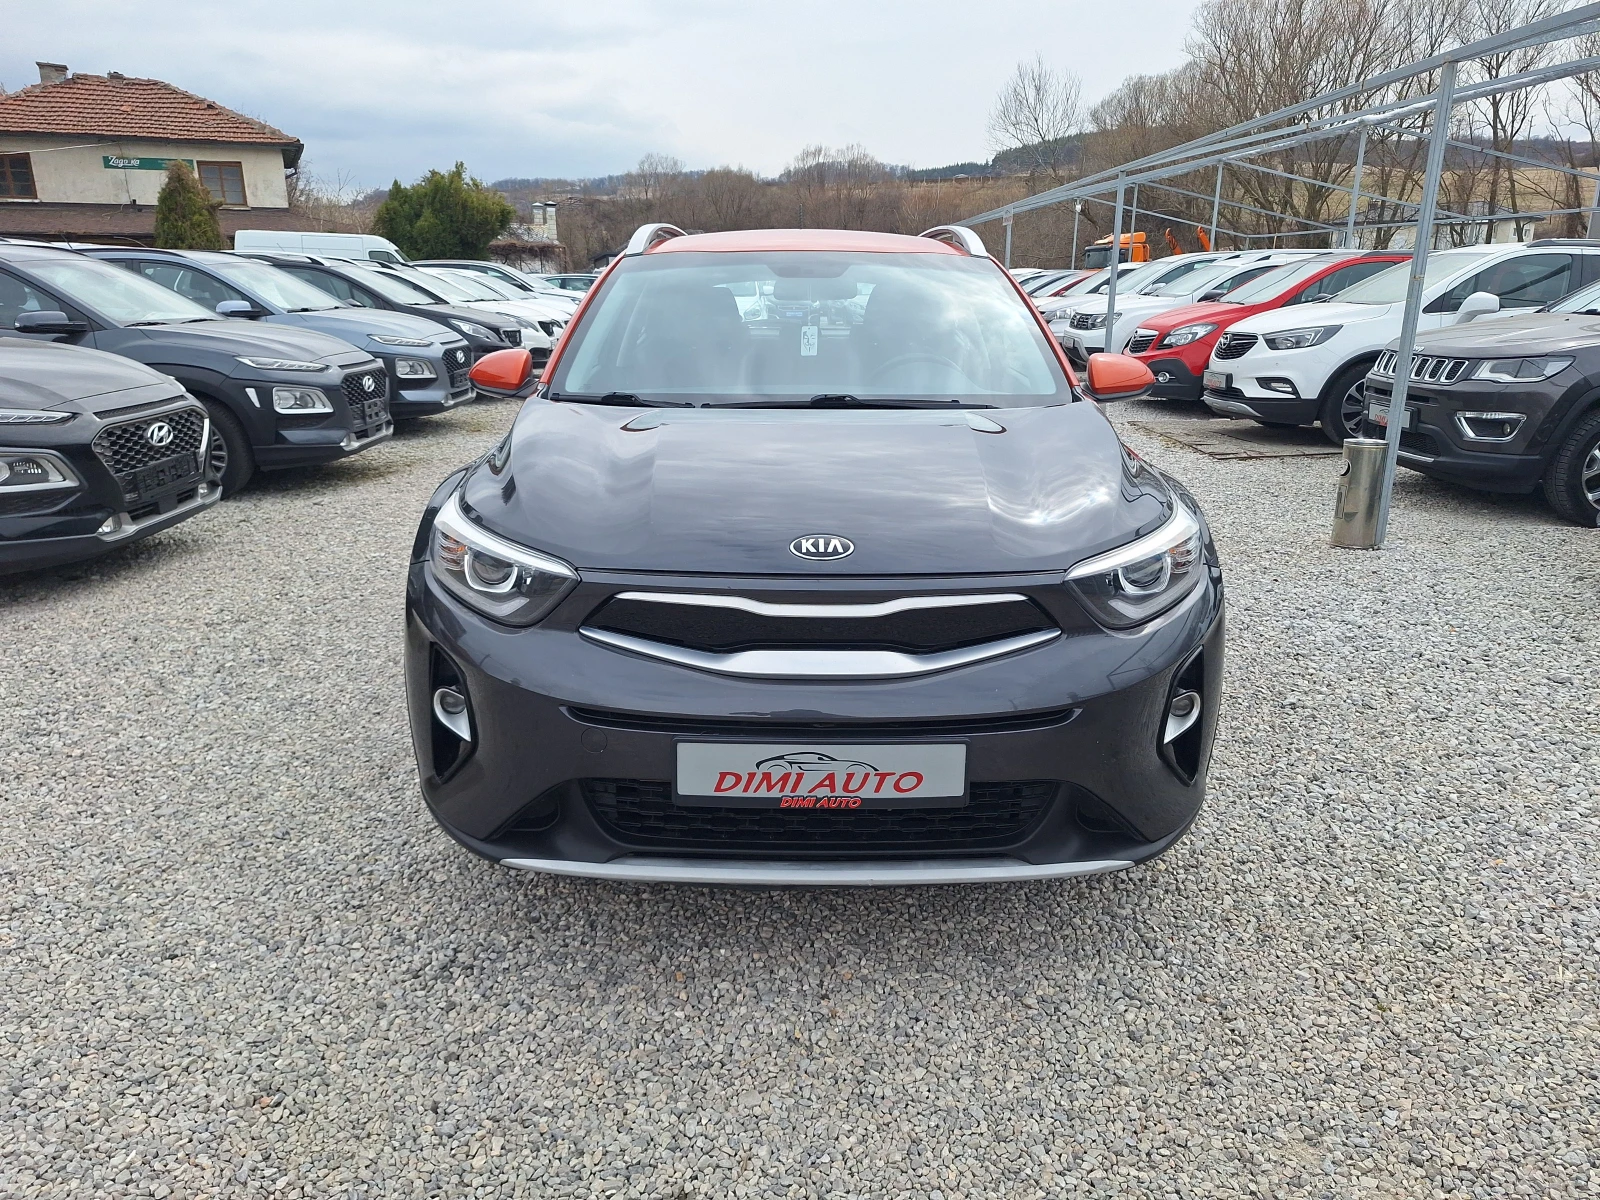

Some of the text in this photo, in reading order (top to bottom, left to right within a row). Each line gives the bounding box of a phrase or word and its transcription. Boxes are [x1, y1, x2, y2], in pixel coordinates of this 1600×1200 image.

[109, 156, 140, 167] Zagoka
[800, 538, 844, 553] KIA
[713, 771, 924, 794] DIMI AUTO
[779, 796, 862, 809] DIMI AUTO
